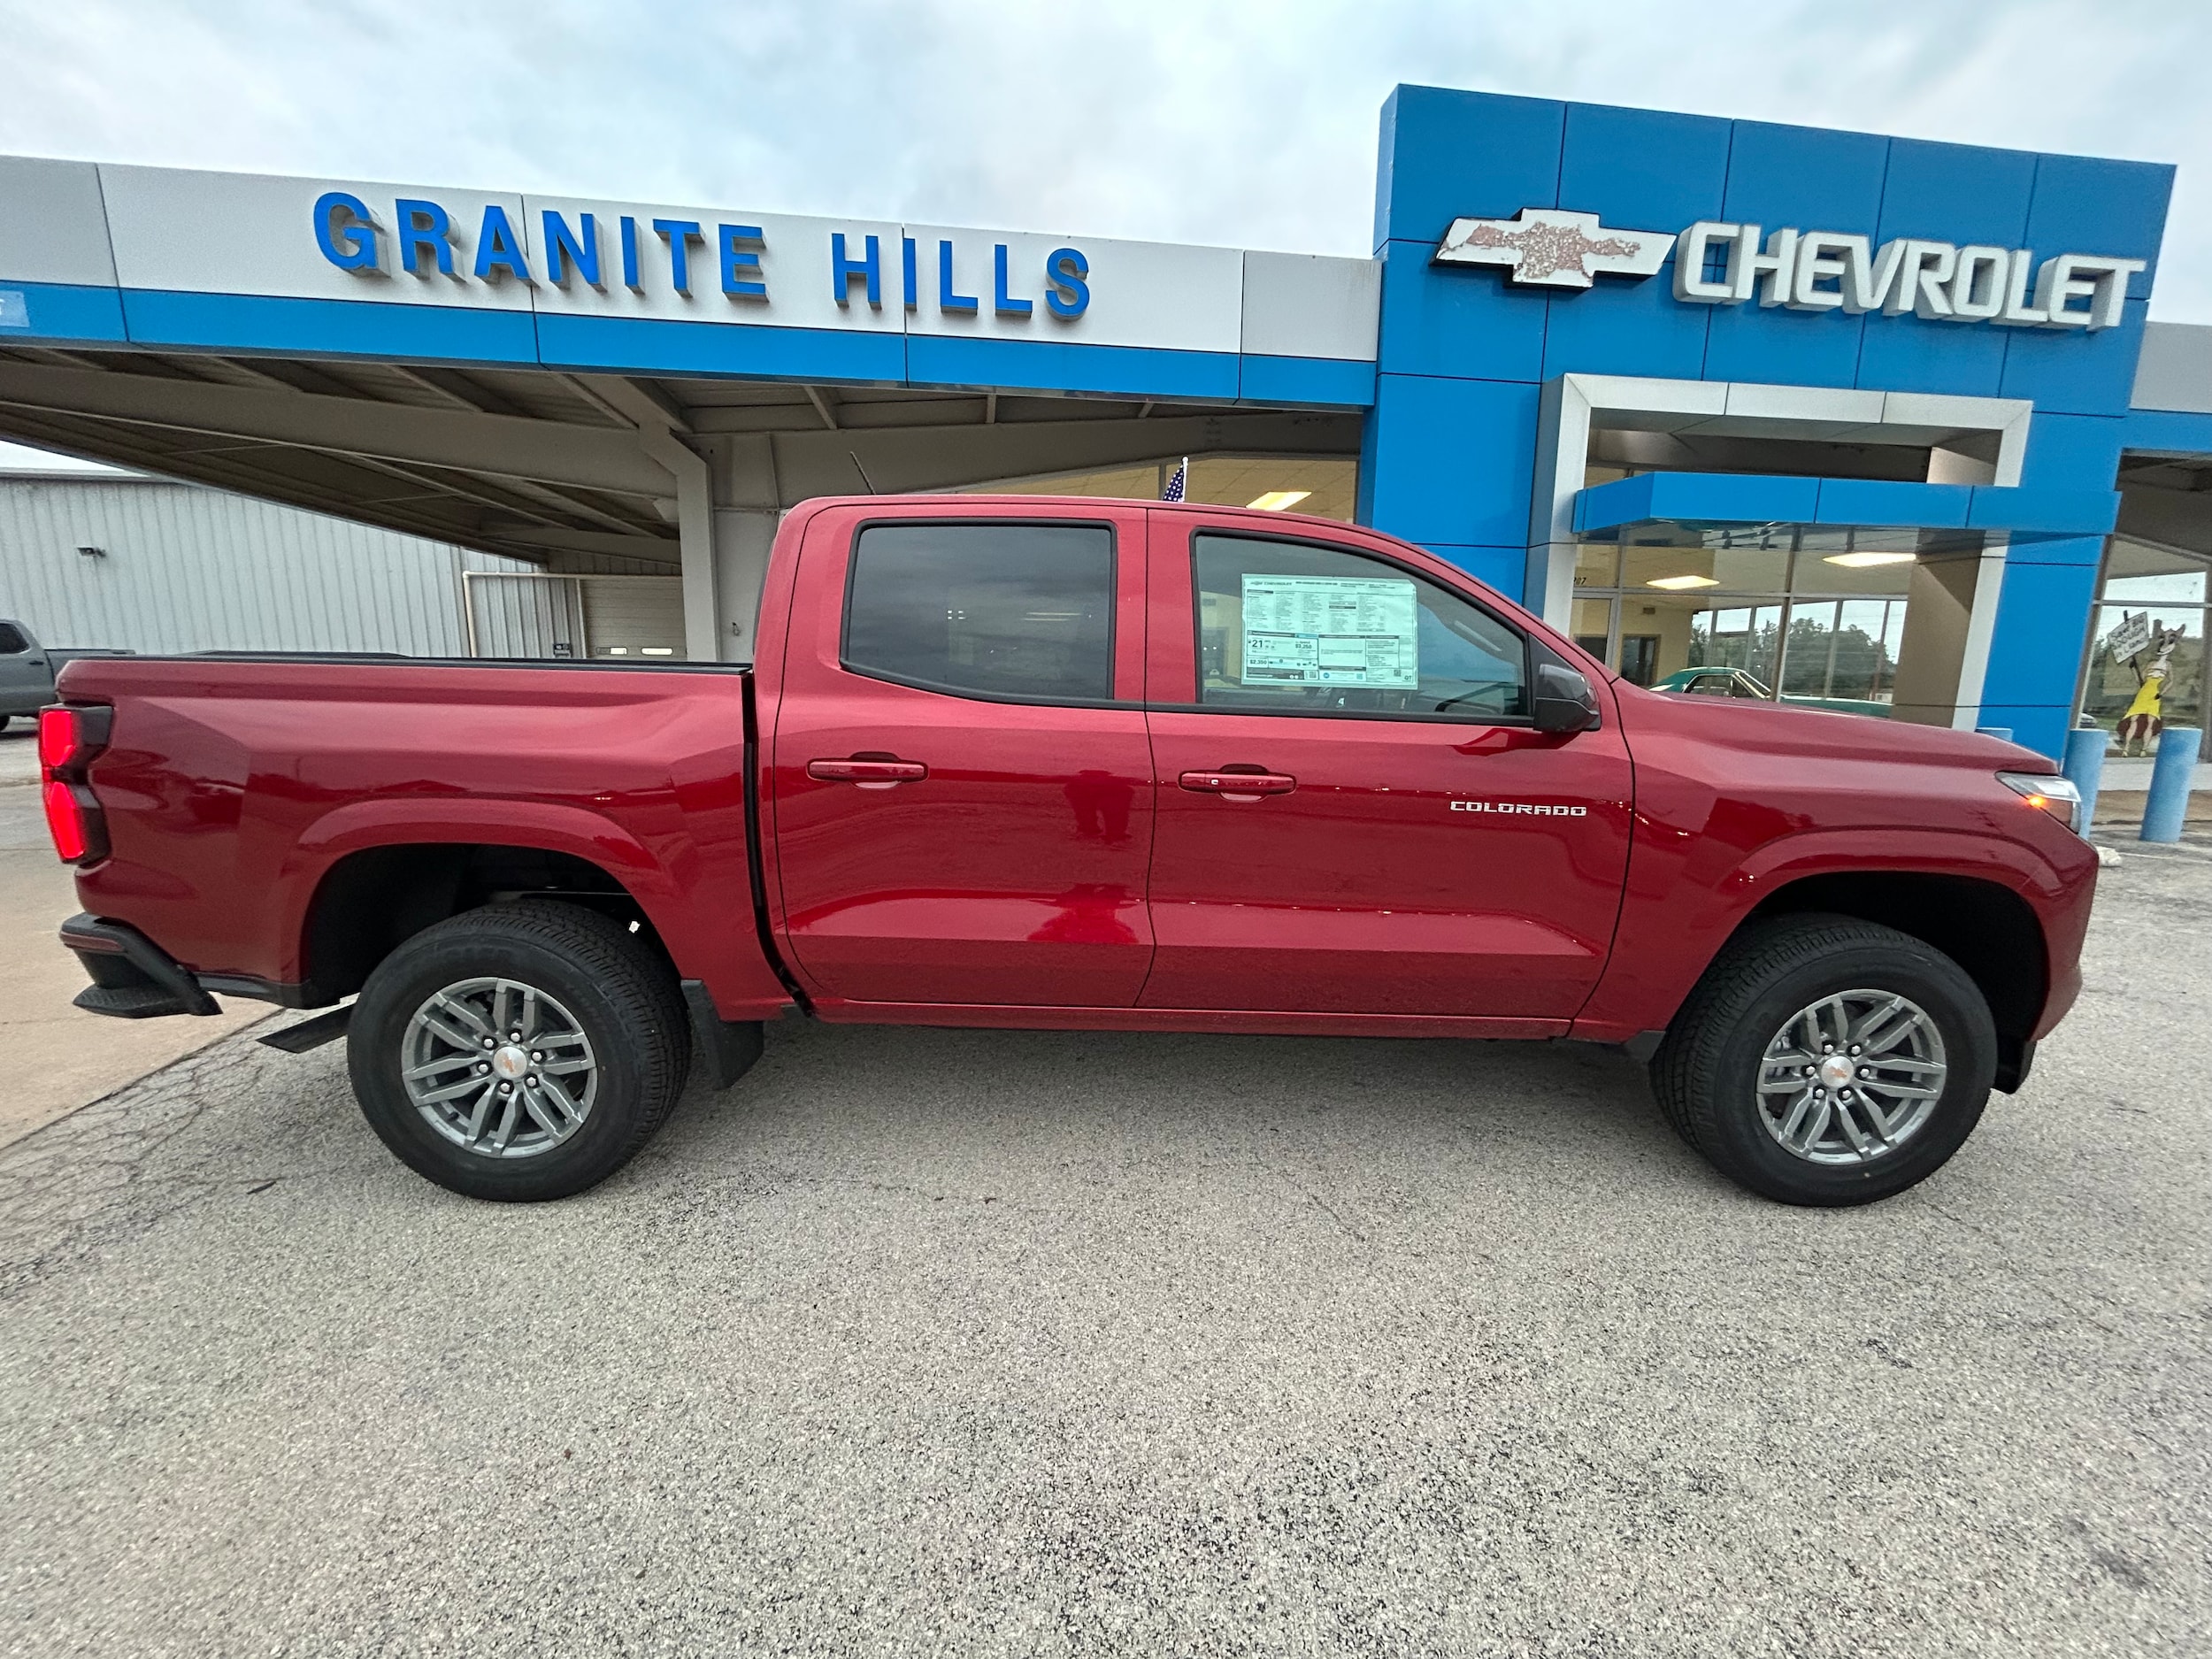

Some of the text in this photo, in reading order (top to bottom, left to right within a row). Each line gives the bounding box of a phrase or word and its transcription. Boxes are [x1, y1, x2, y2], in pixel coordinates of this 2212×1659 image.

[313, 192, 1090, 320] GRANITE HILLS
[1673, 221, 2146, 332] CHEVROLET
[1449, 801, 1587, 817] COLORADO
